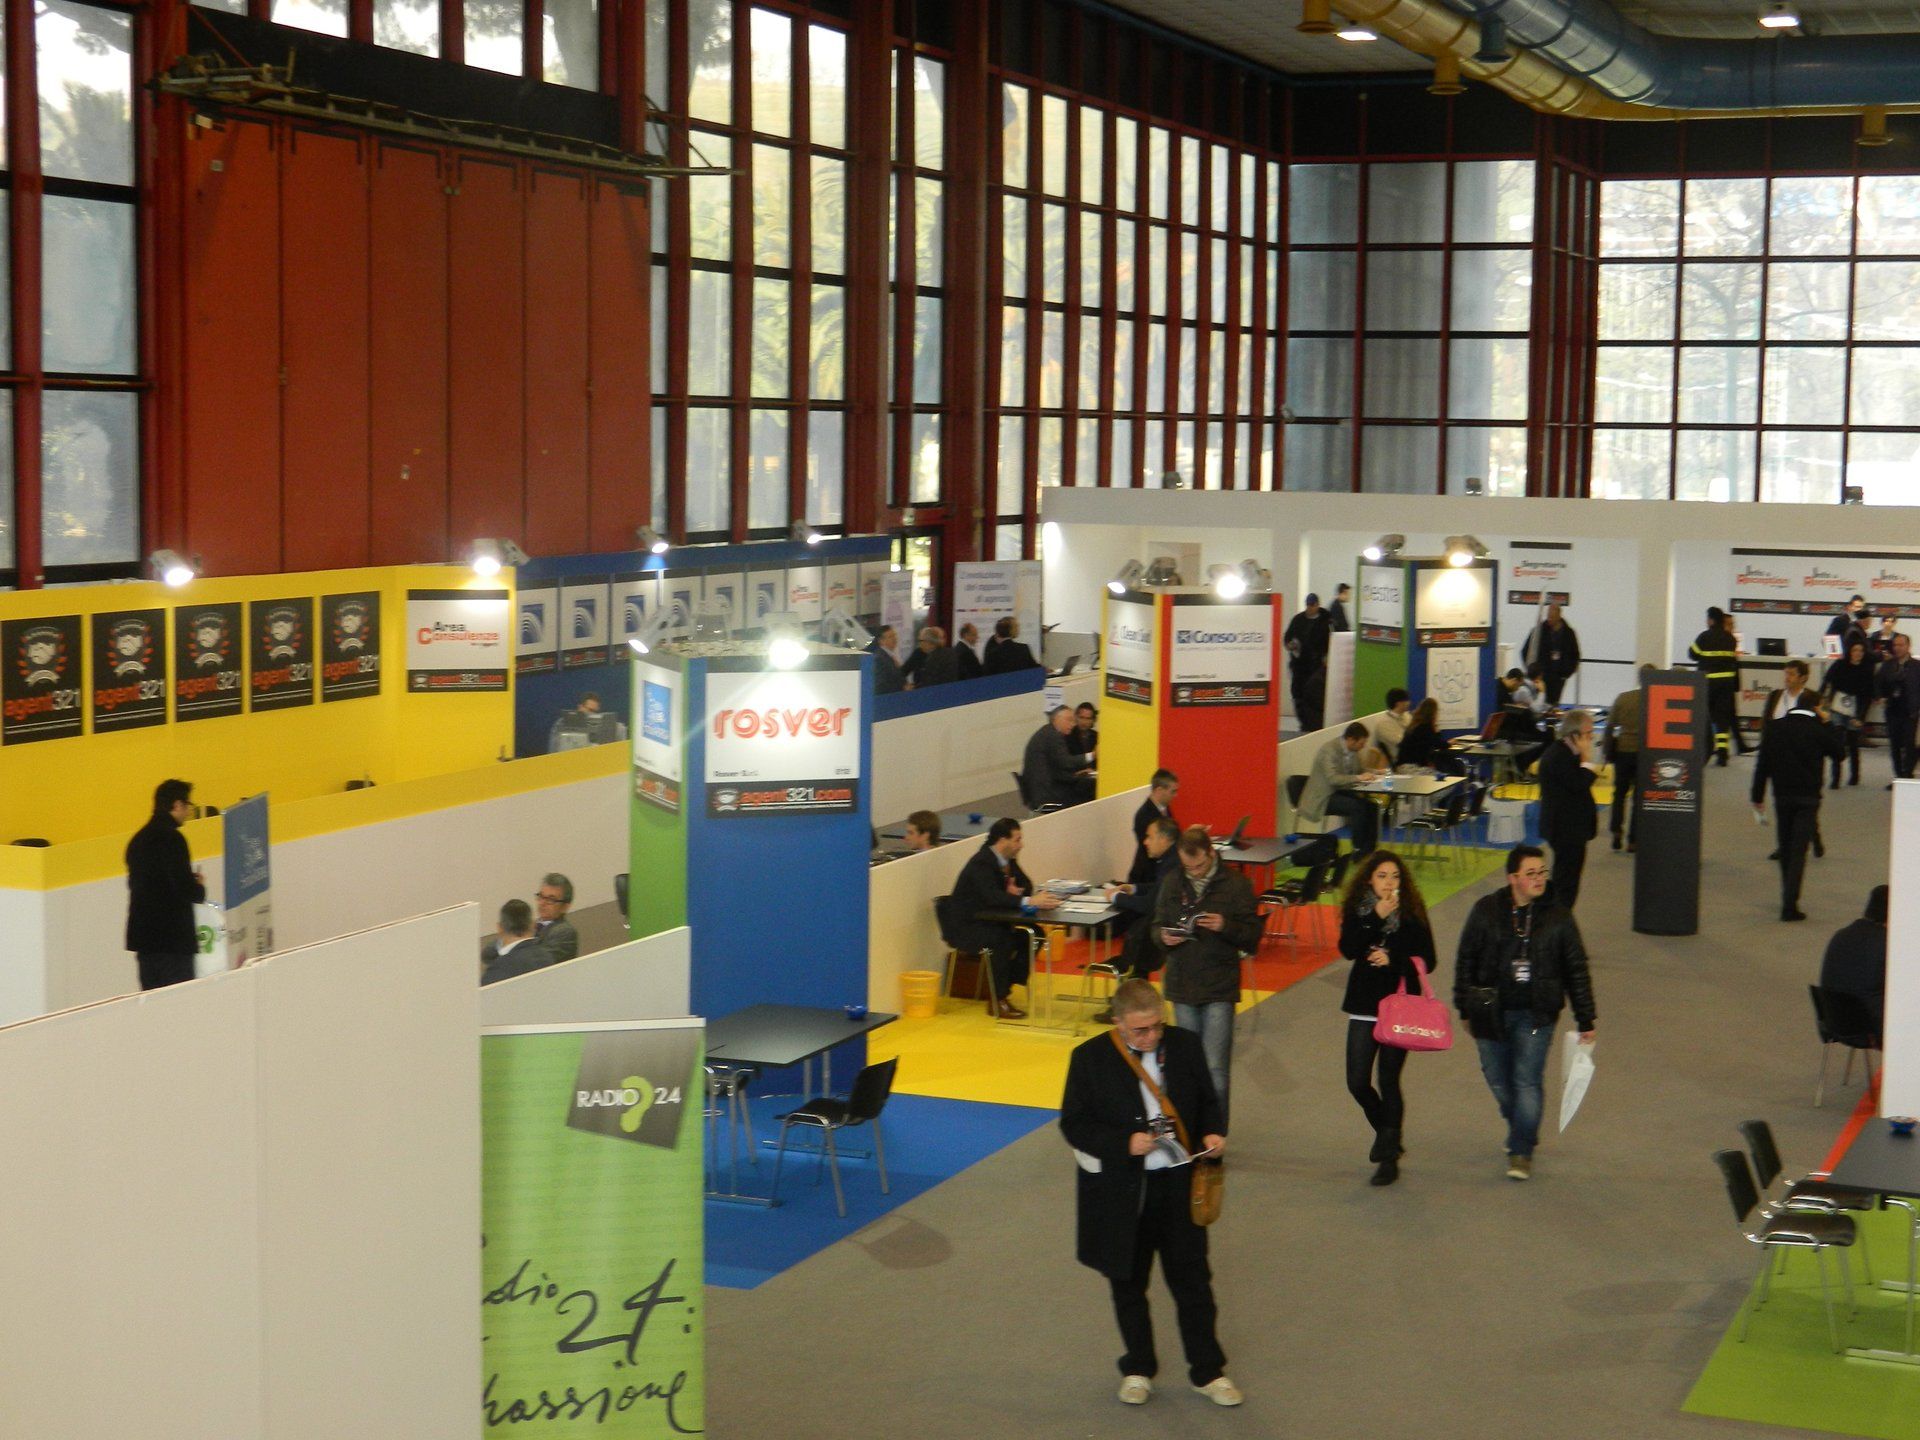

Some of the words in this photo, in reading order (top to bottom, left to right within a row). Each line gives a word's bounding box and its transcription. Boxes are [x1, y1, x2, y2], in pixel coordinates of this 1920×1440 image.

[434, 621, 465, 631] Area
[712, 706, 853, 740] rosver
[1646, 684, 1694, 750] E
[576, 1088, 640, 1108] RADIO
[654, 1086, 682, 1105] 24
